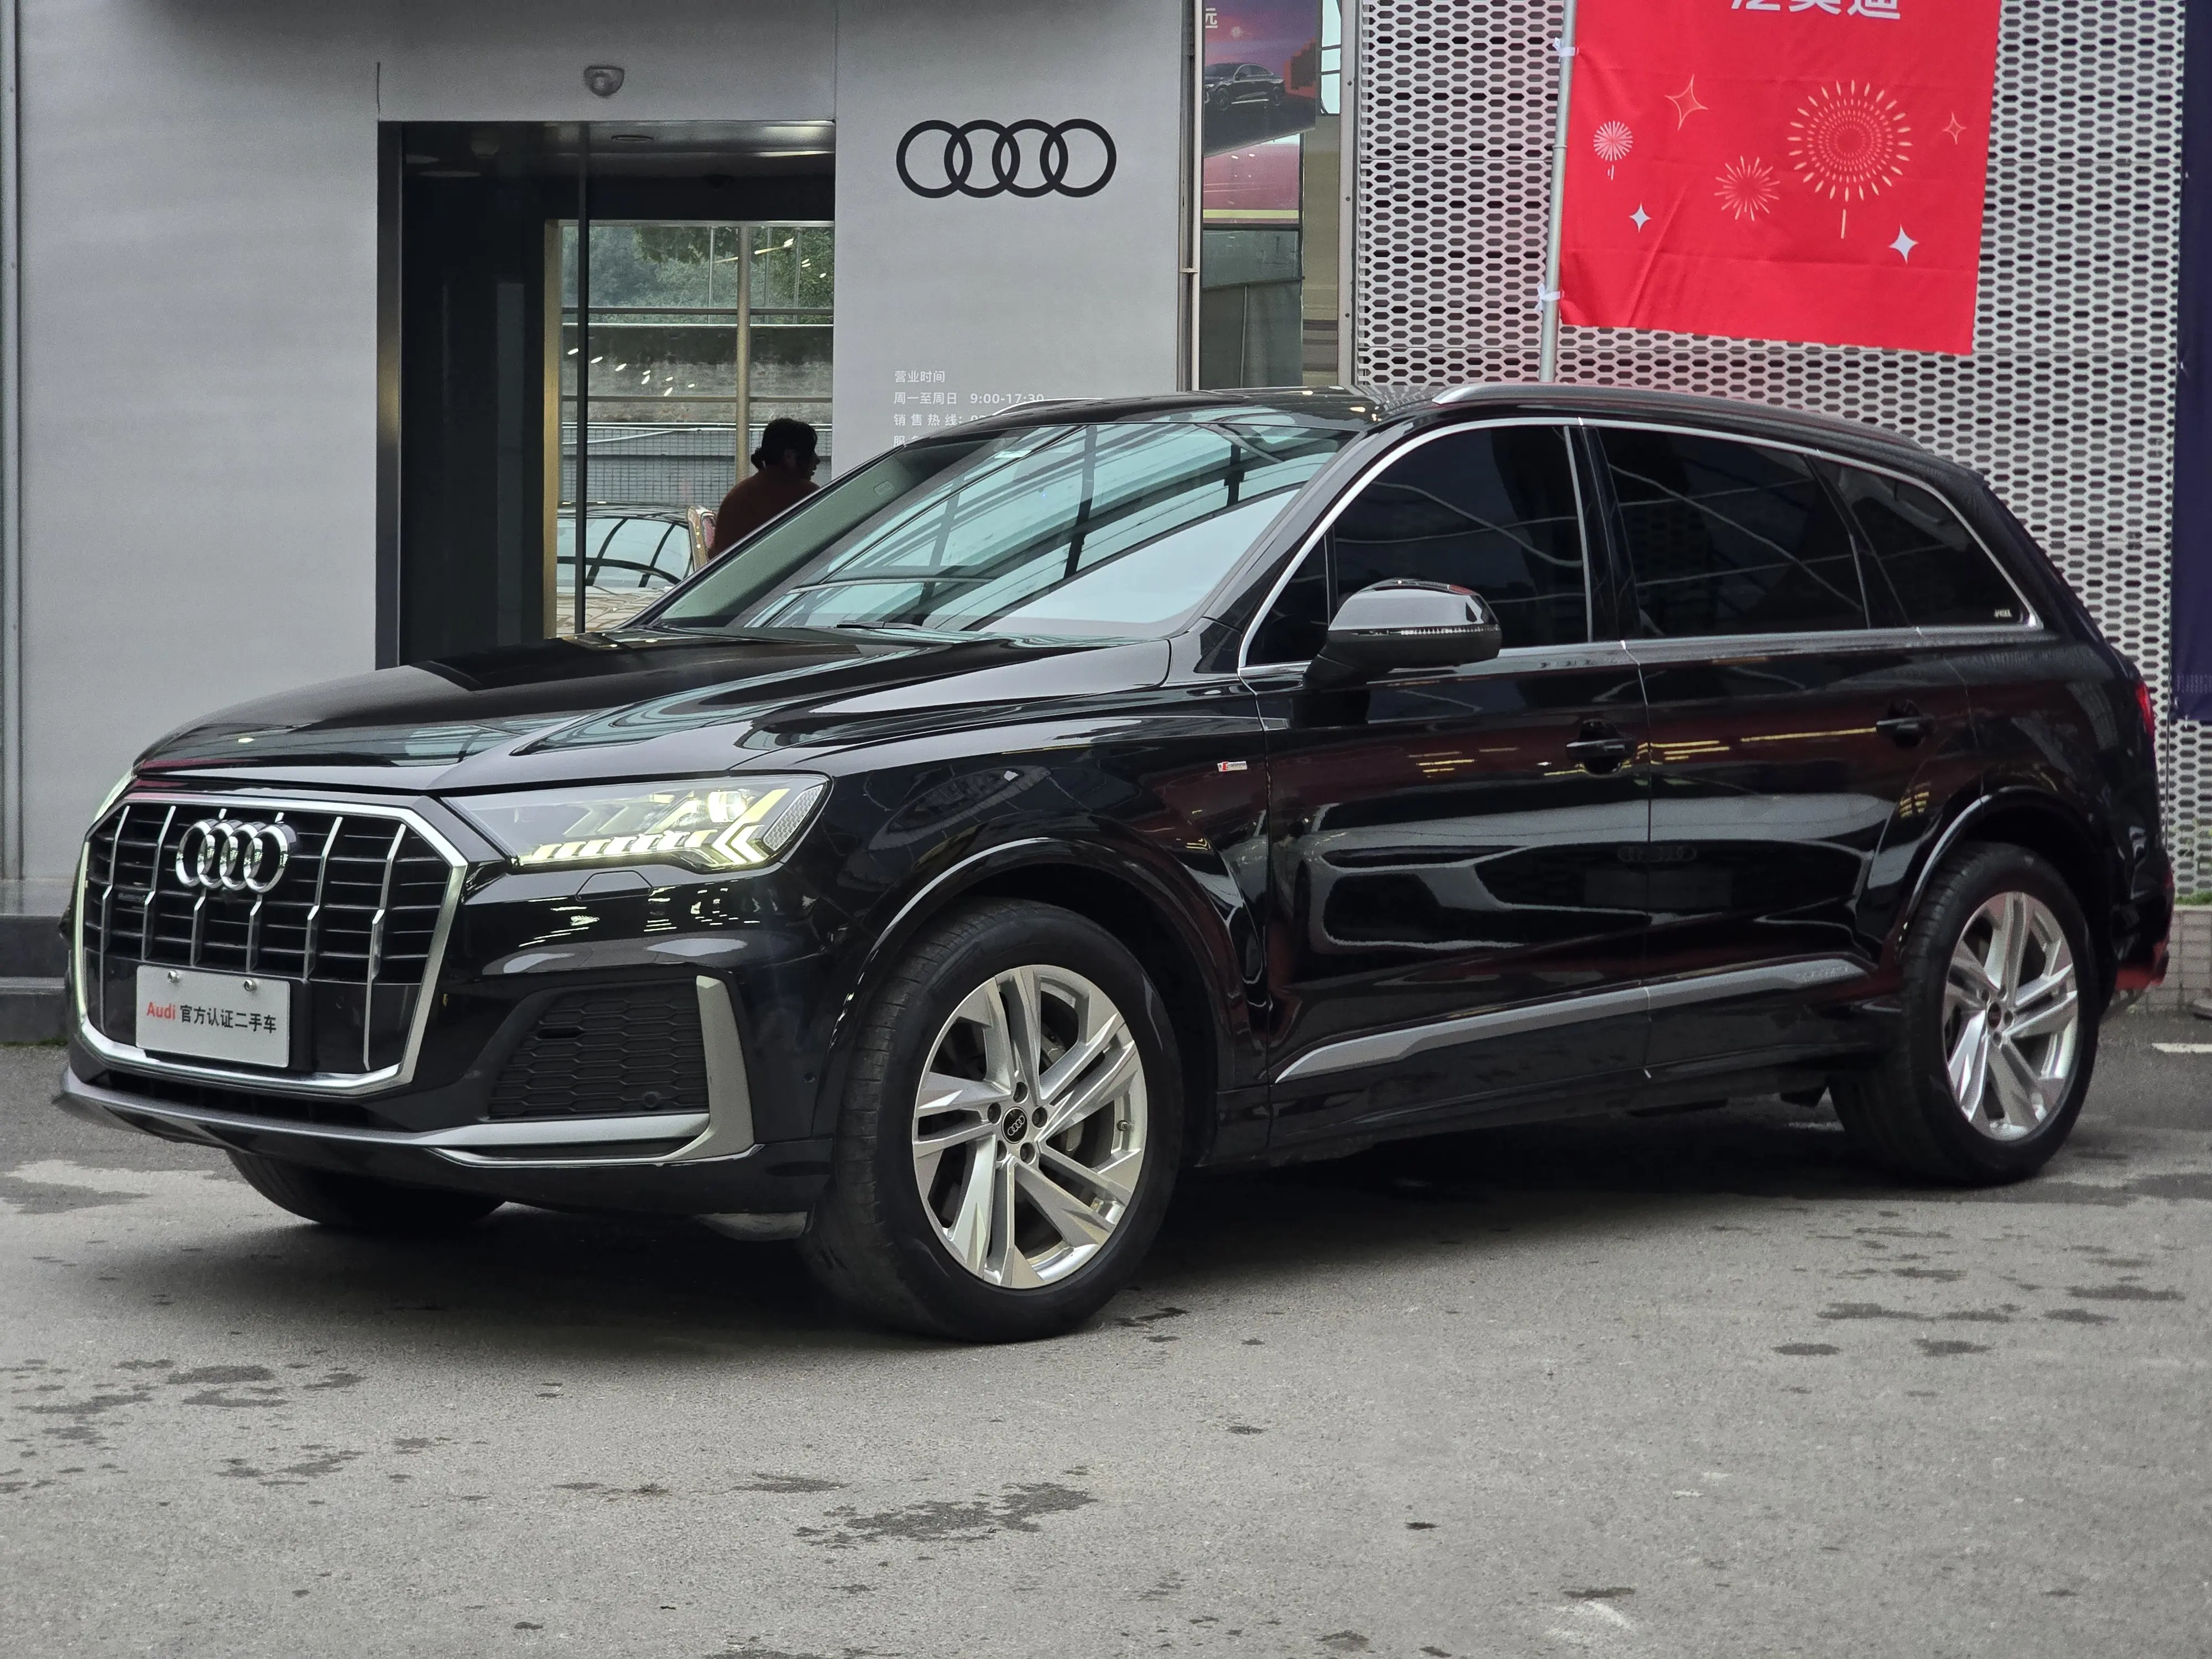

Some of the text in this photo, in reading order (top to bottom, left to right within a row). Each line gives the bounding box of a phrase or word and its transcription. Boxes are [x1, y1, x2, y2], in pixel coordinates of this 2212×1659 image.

[894, 370, 946, 383] 营业时间
[893, 392, 1045, 405] 周一至周日 9:00-17:30
[146, 1001, 277, 1034] Audi 官方认证二手车
